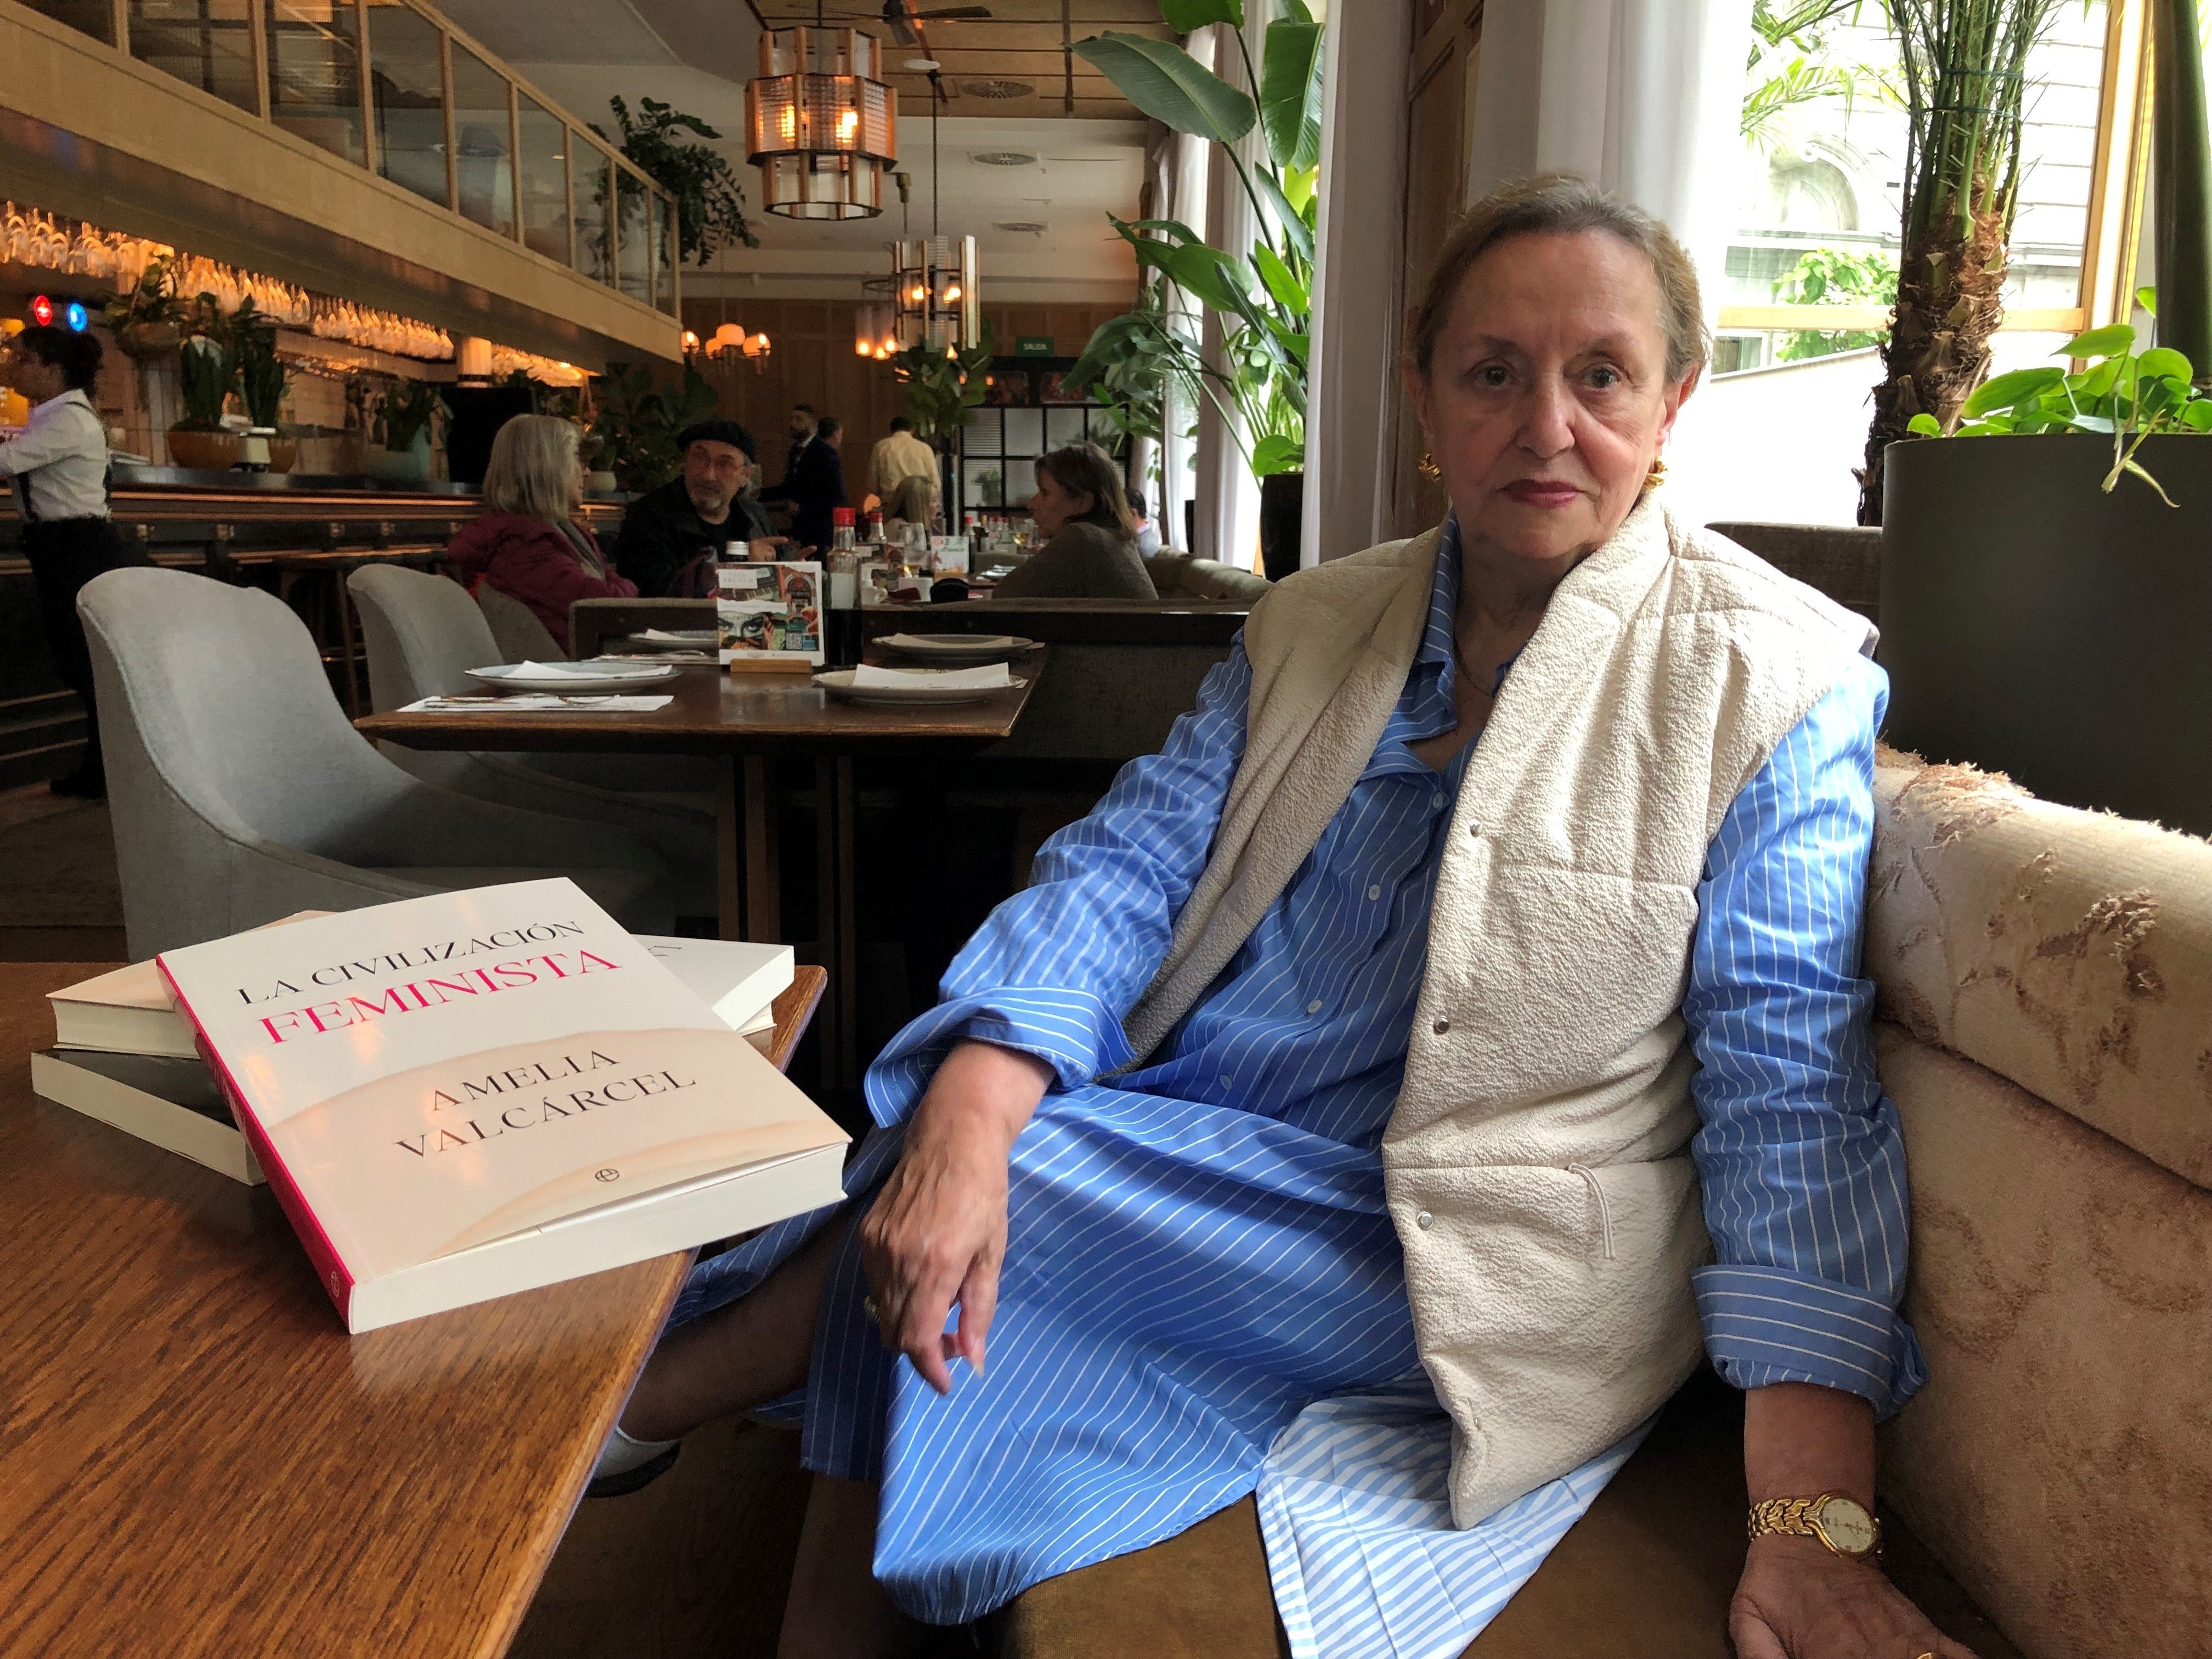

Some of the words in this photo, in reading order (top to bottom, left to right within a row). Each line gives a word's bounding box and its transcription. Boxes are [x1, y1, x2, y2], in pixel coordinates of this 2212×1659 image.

[238, 979, 303, 1005] LA
[311, 921, 585, 986] CIVILIZACIÓN
[258, 950, 622, 1045] FEMINISTA
[394, 1069, 697, 1158] VALCÁRCEL
[432, 1049, 620, 1112] AMELIA
